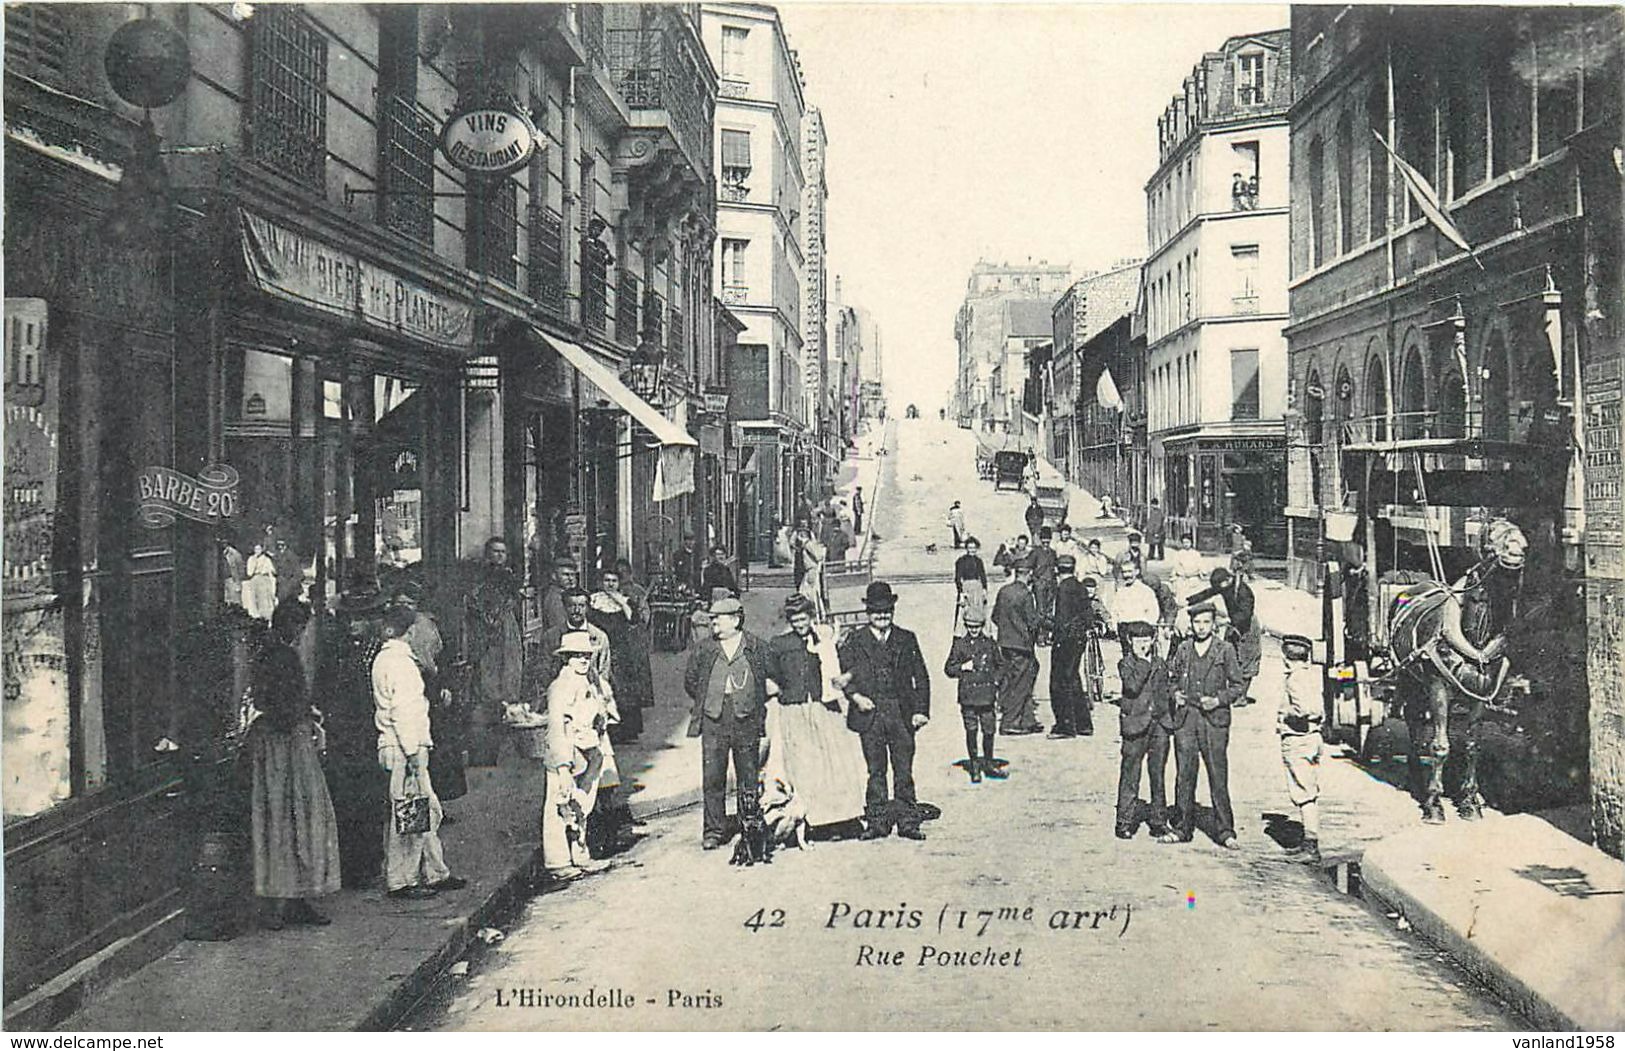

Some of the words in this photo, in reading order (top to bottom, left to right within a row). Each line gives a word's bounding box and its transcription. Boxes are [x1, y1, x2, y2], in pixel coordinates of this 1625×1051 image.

[466, 114, 508, 133] VINS
[450, 139, 523, 167] RESTAURANT
[139, 474, 205, 511] BARBE
